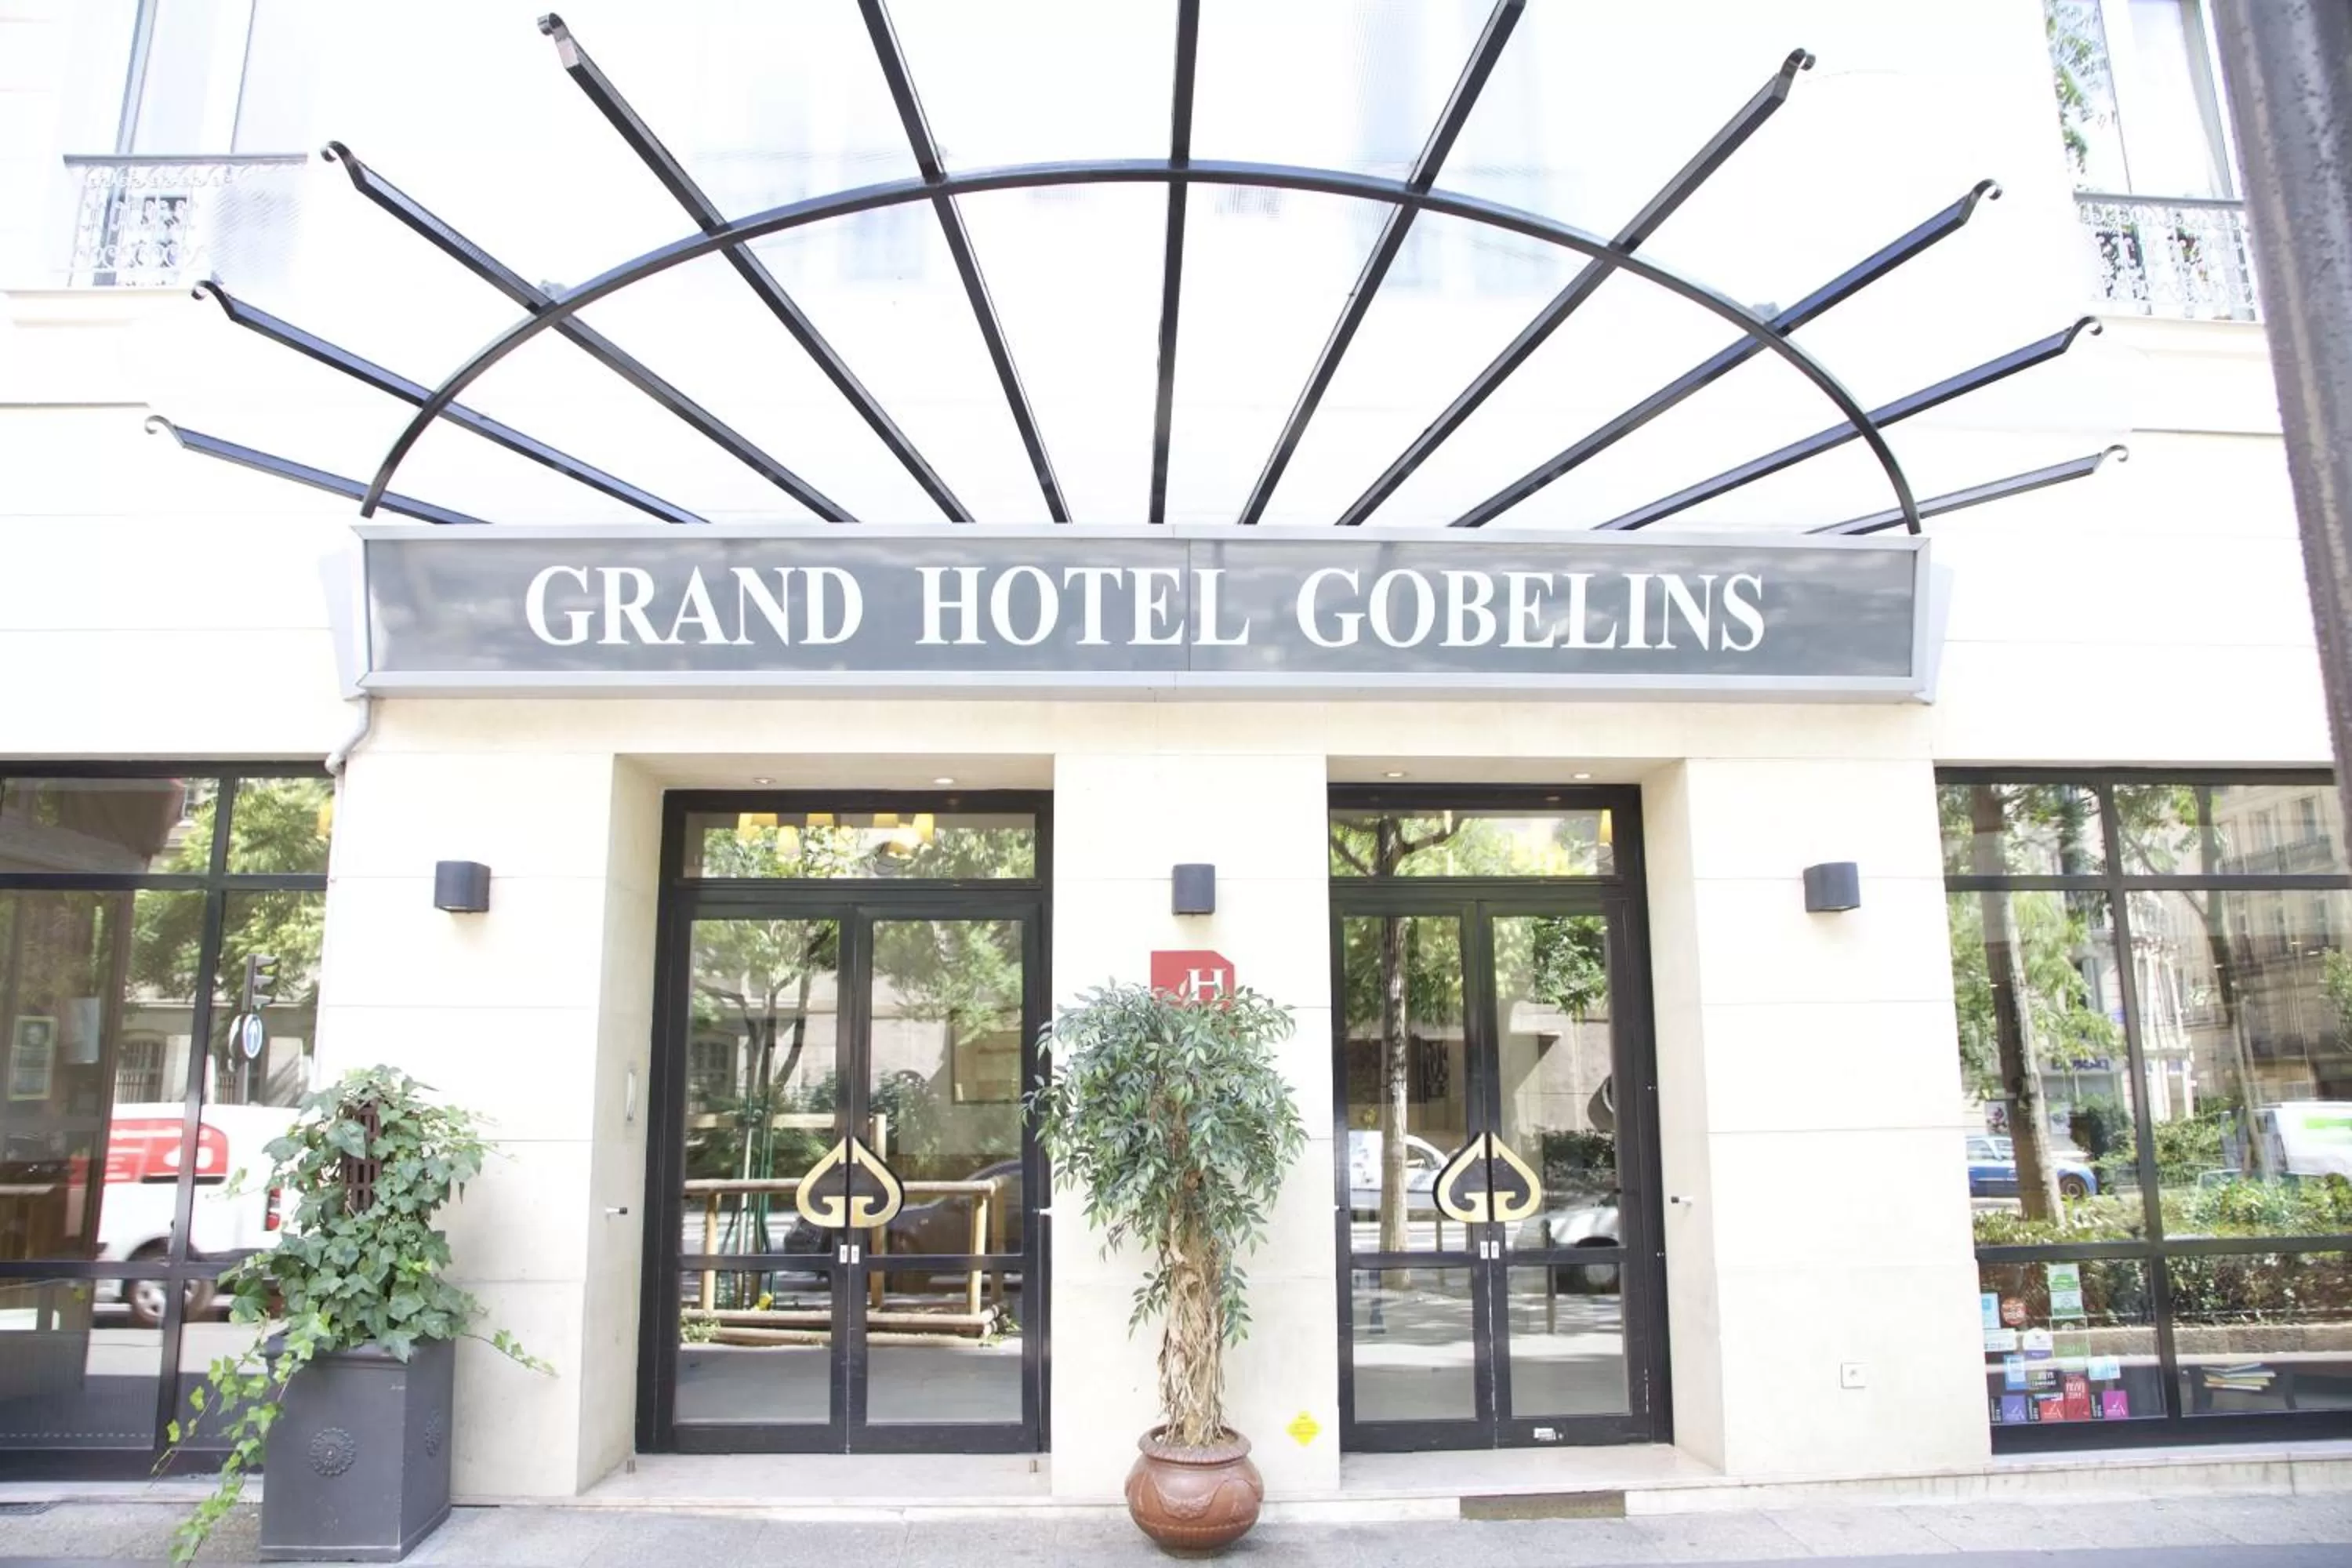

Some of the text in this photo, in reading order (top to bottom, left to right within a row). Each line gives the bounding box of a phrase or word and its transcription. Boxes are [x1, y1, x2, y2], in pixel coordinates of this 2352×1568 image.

[526, 566, 1765, 651] GRAND HOTEL GOBELINS
[1186, 967, 1227, 1002] H
